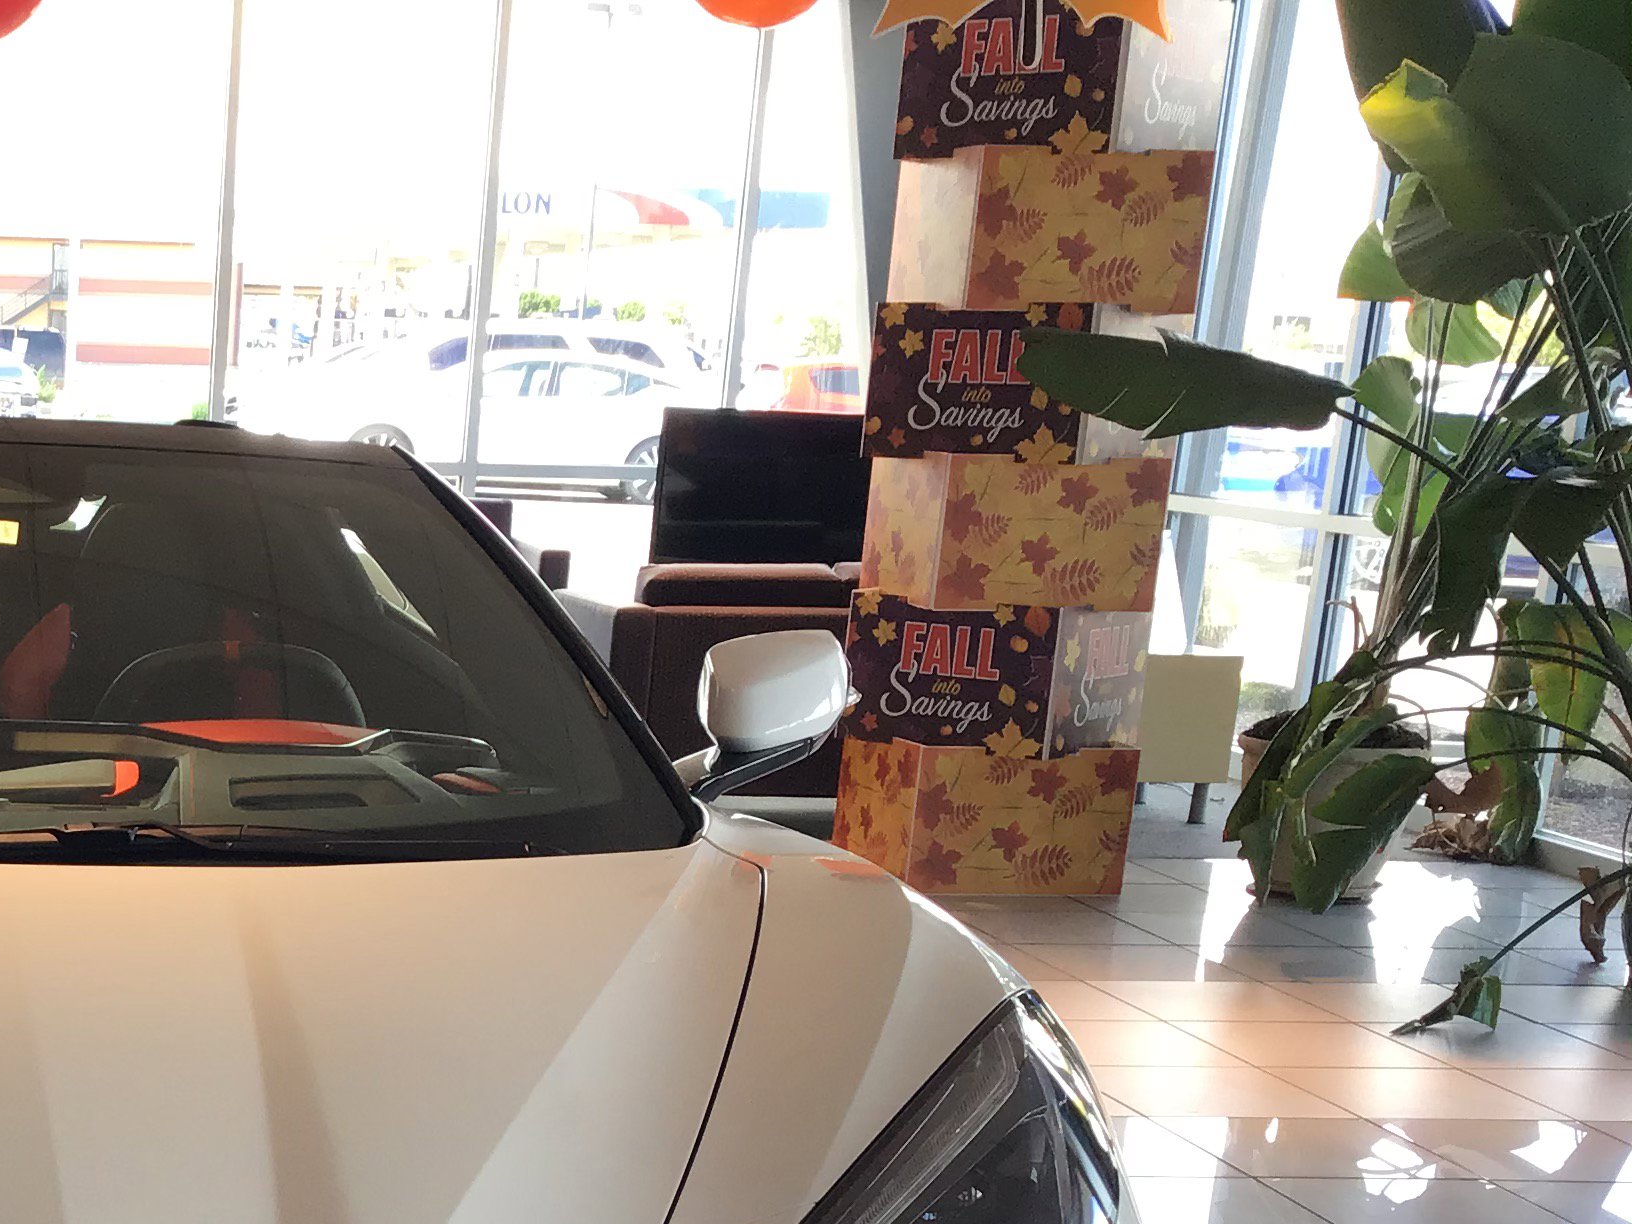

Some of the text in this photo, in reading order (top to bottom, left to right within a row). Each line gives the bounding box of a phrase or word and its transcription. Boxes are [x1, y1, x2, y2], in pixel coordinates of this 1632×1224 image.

[940, 62, 1058, 137] Savings
[995, 77, 1025, 95] into
[1144, 59, 1198, 140] Savings
[907, 370, 1025, 443] Savings
[962, 386, 992, 403] into
[899, 621, 1000, 681] FALL
[1085, 624, 1130, 681] FALL
[880, 660, 992, 734] Savings
[931, 679, 961, 696] into
[1074, 671, 1122, 732] Savings
